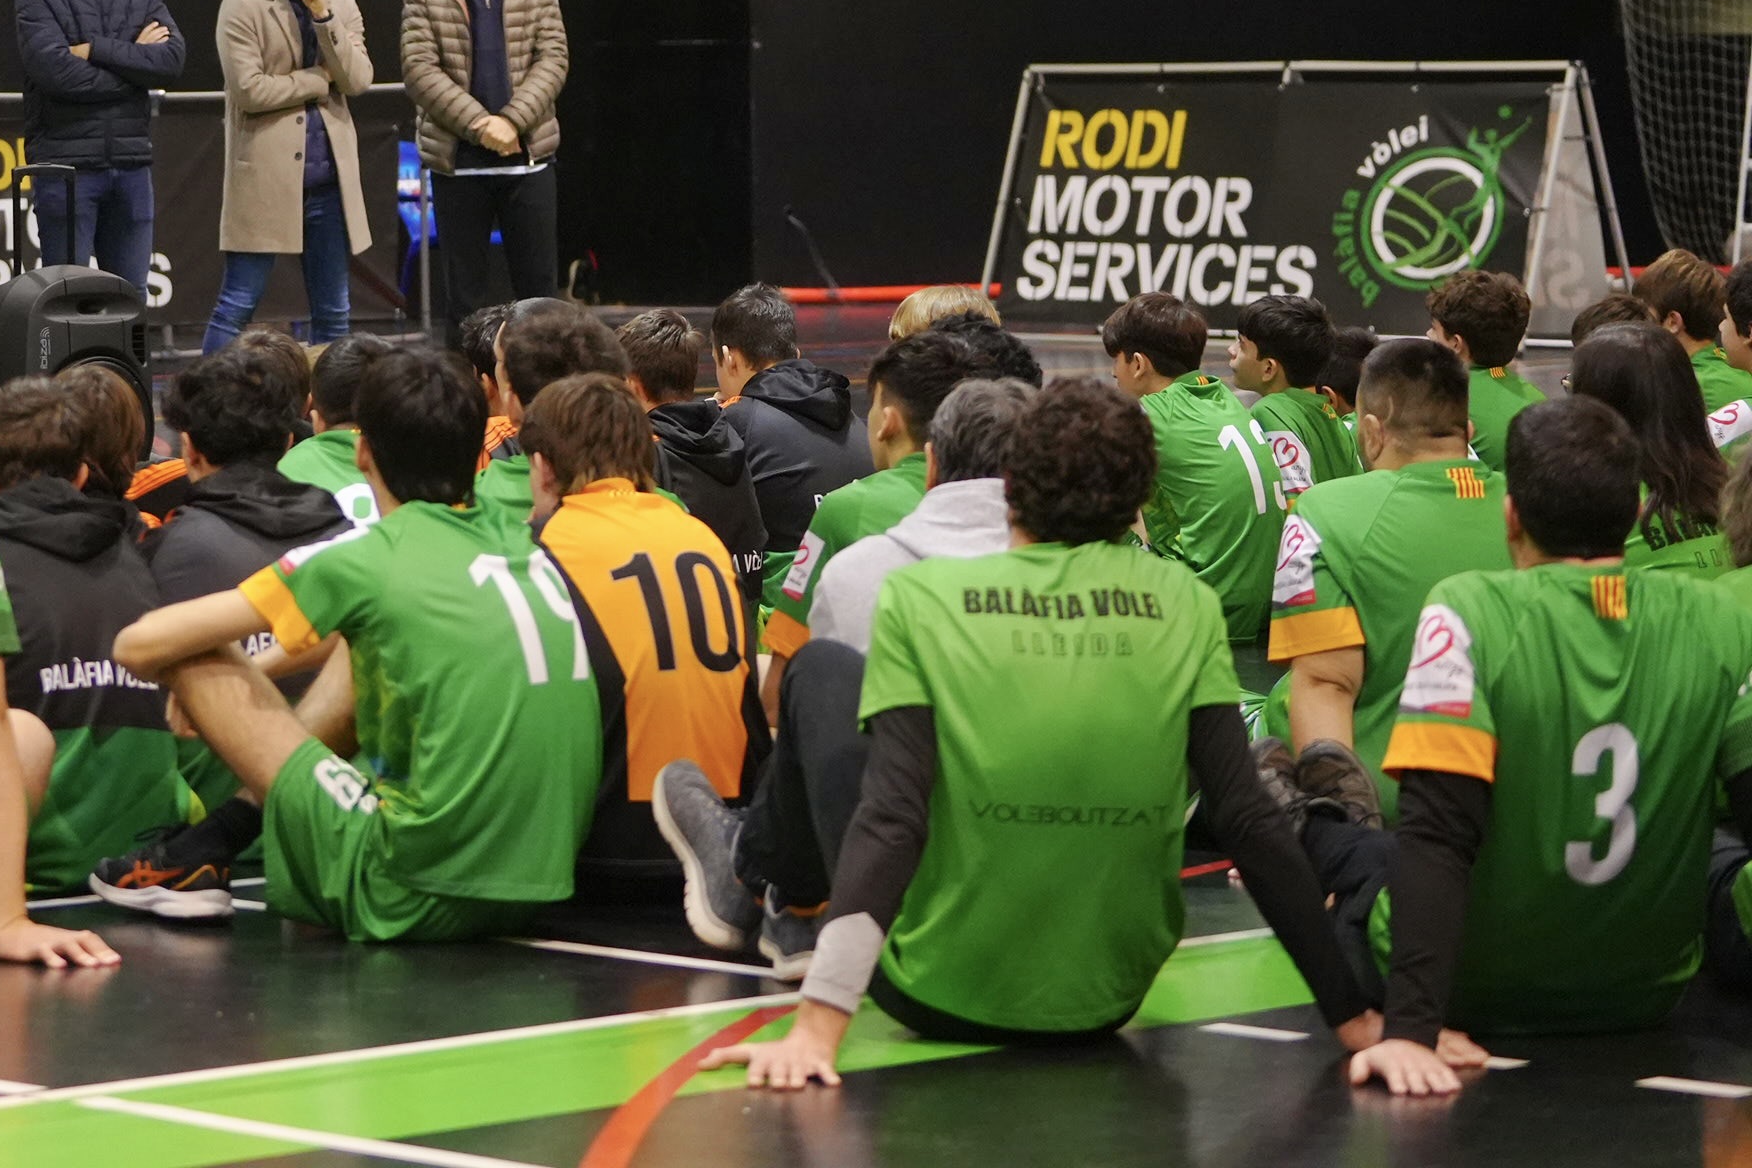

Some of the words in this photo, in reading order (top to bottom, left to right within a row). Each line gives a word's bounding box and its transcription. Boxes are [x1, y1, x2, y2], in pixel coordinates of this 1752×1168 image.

[1039, 109, 1188, 170] RODI
[1026, 175, 1254, 238] MOTOR
[1016, 239, 1317, 307] SERVICES
[610, 550, 744, 673] 10
[1010, 629, 1134, 657] LLEIDA
[39, 656, 115, 694] BALÀFIA
[1564, 722, 1640, 886] 3
